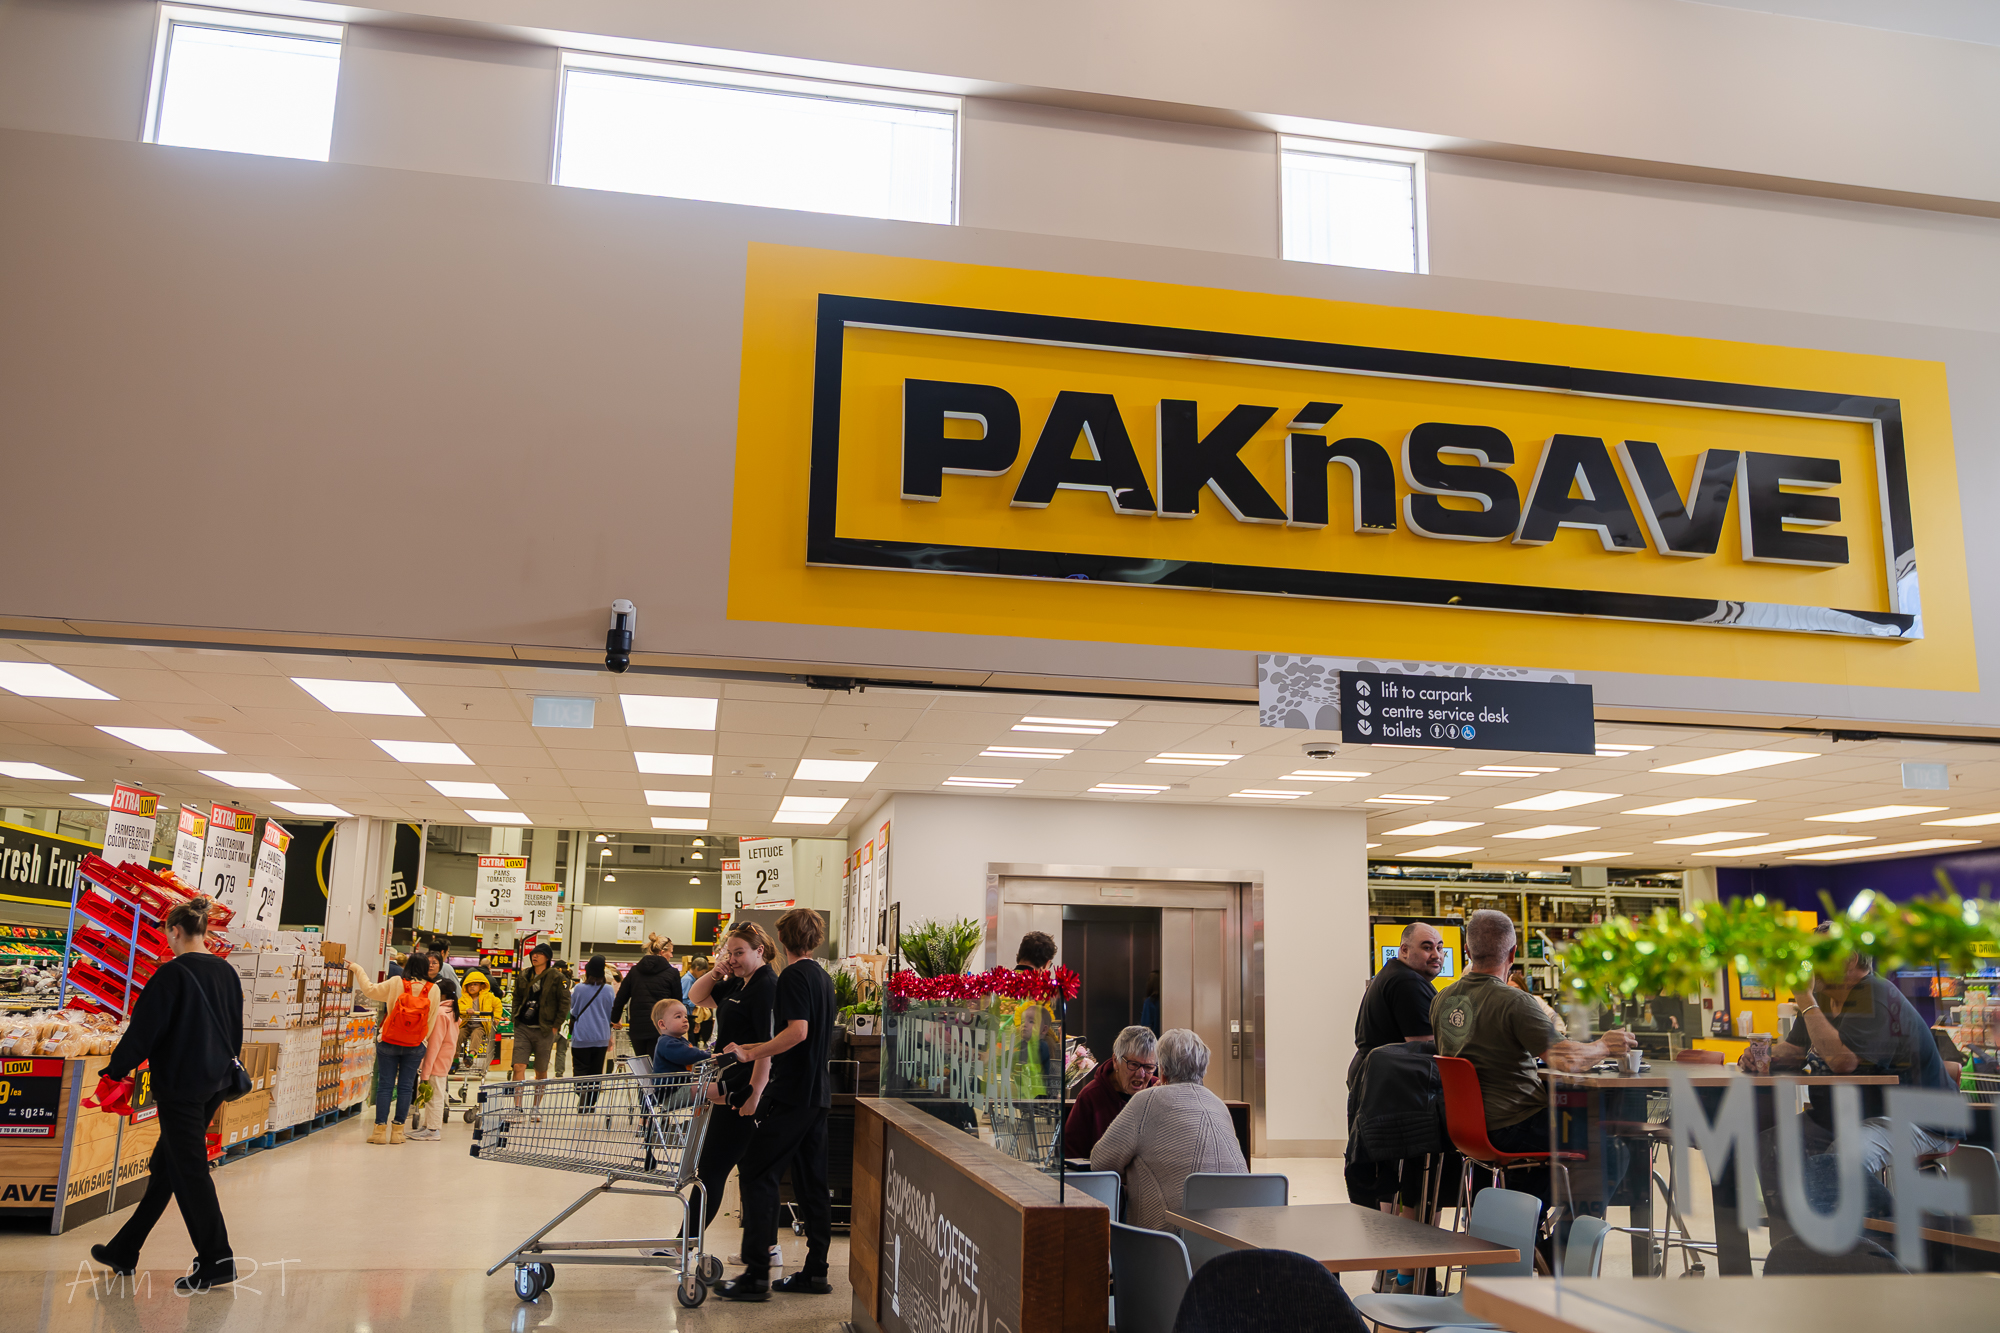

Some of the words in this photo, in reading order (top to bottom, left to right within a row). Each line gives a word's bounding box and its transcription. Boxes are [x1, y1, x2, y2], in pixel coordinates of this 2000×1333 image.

[1381, 681, 1399, 698] lift
[1402, 685, 1416, 699] to
[1419, 686, 1472, 705] carpark
[1382, 705, 1424, 721] centre
[1428, 706, 1475, 722] service
[1478, 706, 1509, 723] desk
[1382, 721, 1422, 738] toilets
[114, 789, 140, 812] EXTRA
[140, 799, 156, 815] LOW
[180, 811, 194, 833] EXTRA
[212, 808, 236, 828] EXTRA
[236, 817, 253, 830] LOW
[114, 823, 135, 837] FARMER
[136, 827, 150, 840] BROWN
[265, 824, 280, 848] EXTRA
[107, 834, 127, 849] COLONY
[128, 838, 141, 851] EGGS
[215, 835, 245, 851] SANITARIUM
[206, 846, 213, 857] SO
[213, 847, 228, 860] GOOD
[228, 851, 237, 861] OAT
[237, 854, 250, 864] MILK
[481, 857, 505, 867] EXTRA
[506, 859, 523, 867] LOW
[748, 846, 784, 860] LETTUCE
[47, 846, 87, 892] Frui
[524, 893, 553, 901] TELEGRAPH
[6, 1063, 31, 1074] LOW
[896, 1016, 946, 1095] MUFFIN
[950, 1025, 1015, 1125] BREAK
[1668, 1065, 2000, 1272] MUF
[937, 1213, 979, 1295] COFFEE
